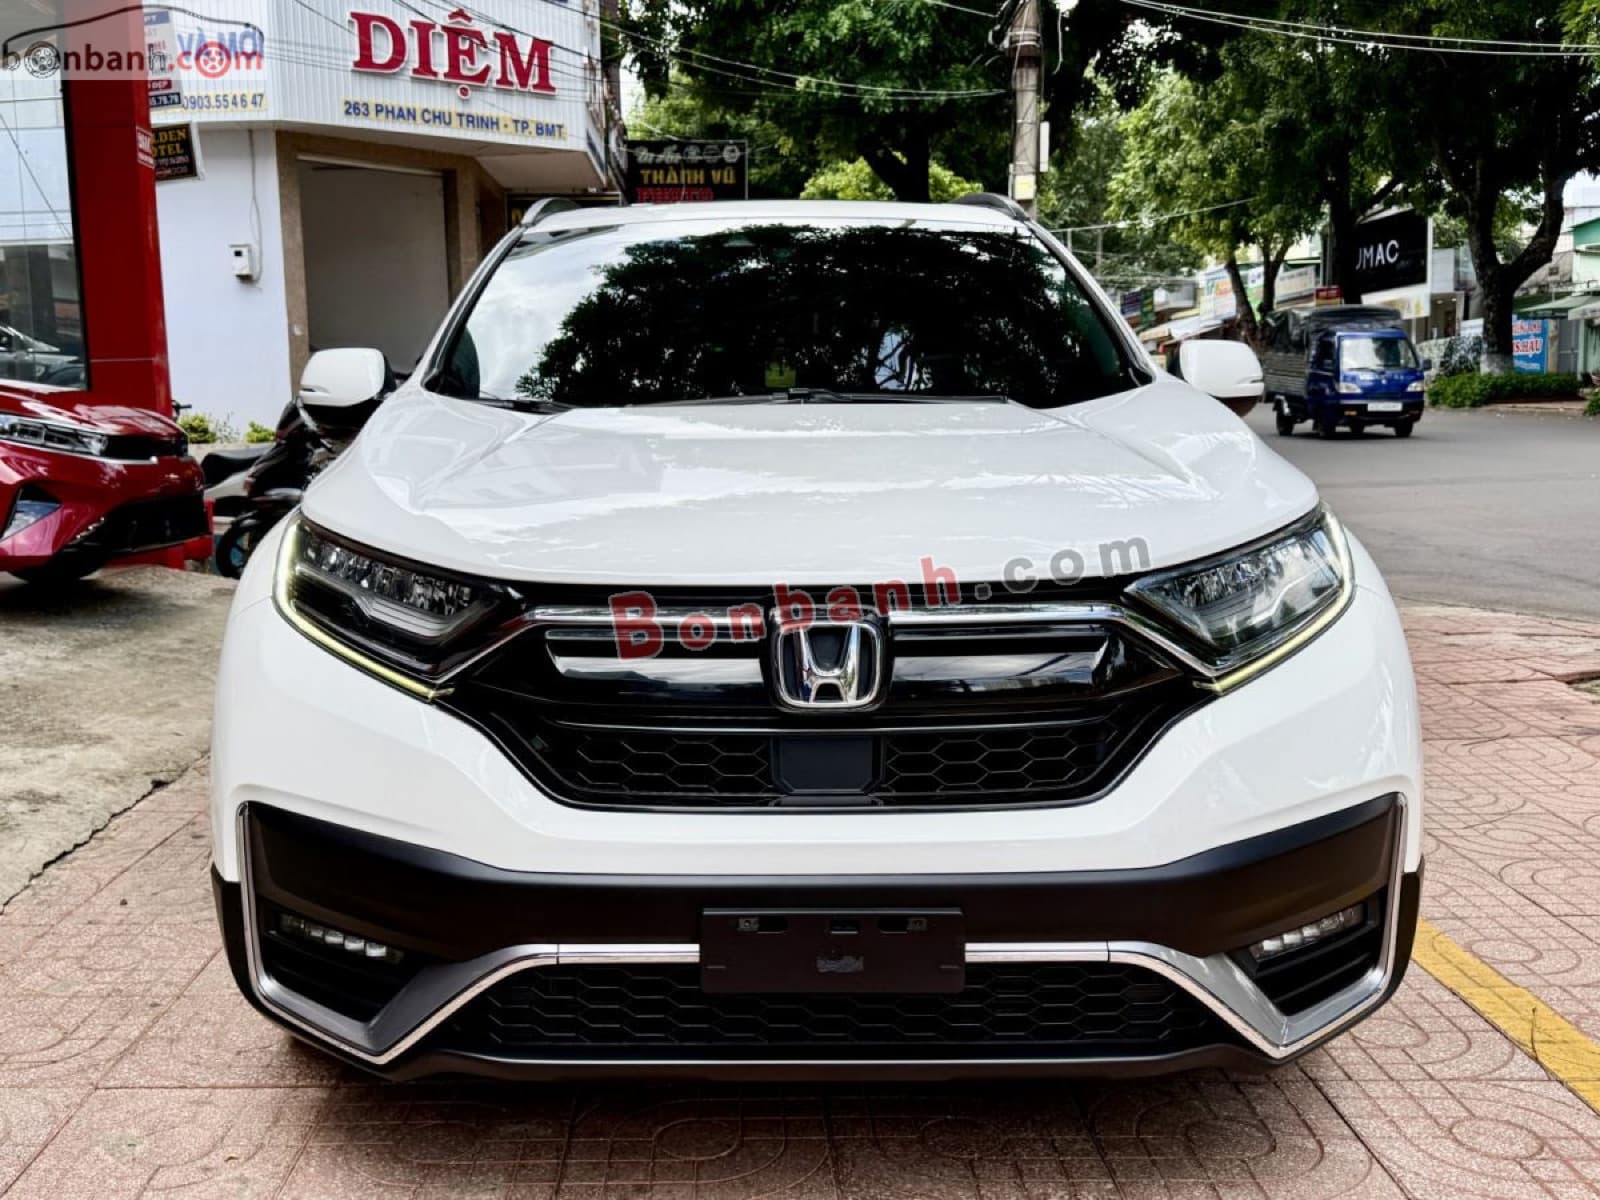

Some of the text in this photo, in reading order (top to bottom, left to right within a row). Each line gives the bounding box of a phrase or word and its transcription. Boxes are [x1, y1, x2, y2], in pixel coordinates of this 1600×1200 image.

[350, 8, 557, 100] DIỆM
[344, 100, 369, 117] 263
[375, 104, 416, 122] PHAN
[421, 108, 452, 126] CHU
[456, 112, 499, 131] TRINH
[1355, 239, 1400, 271] JMAC
